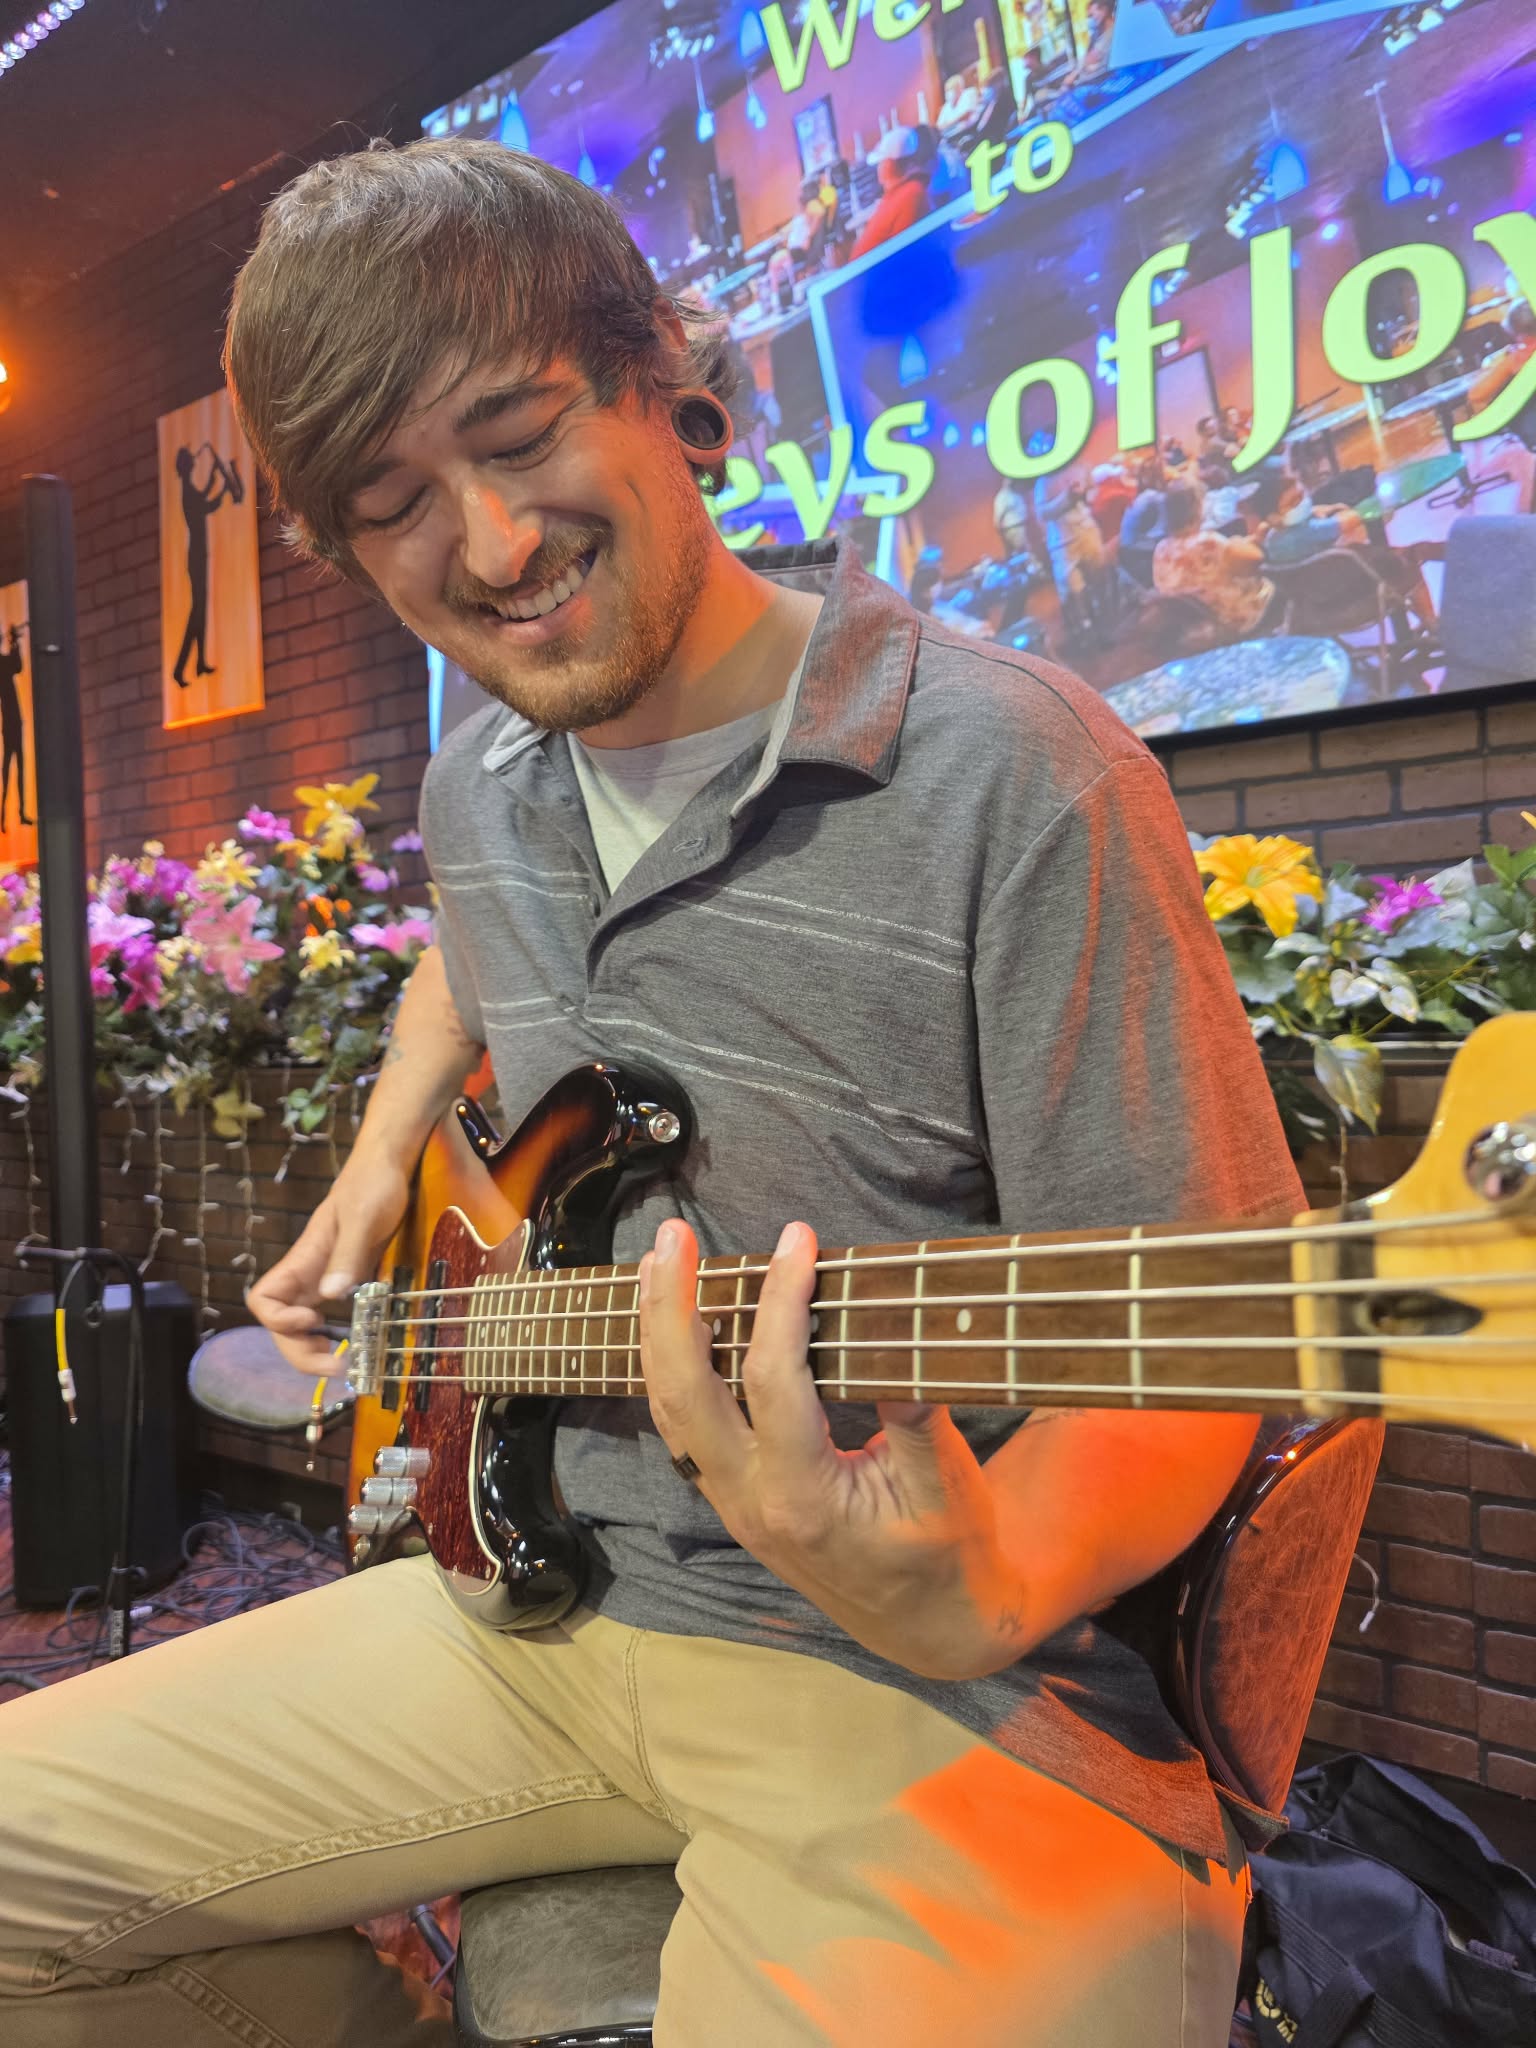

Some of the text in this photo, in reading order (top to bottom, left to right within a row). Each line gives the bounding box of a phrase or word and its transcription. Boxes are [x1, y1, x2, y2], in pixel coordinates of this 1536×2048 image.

[760, 0, 964, 94] We
[965, 121, 1073, 215] to
[700, 401, 935, 549] eys
[985, 242, 1190, 479] of
